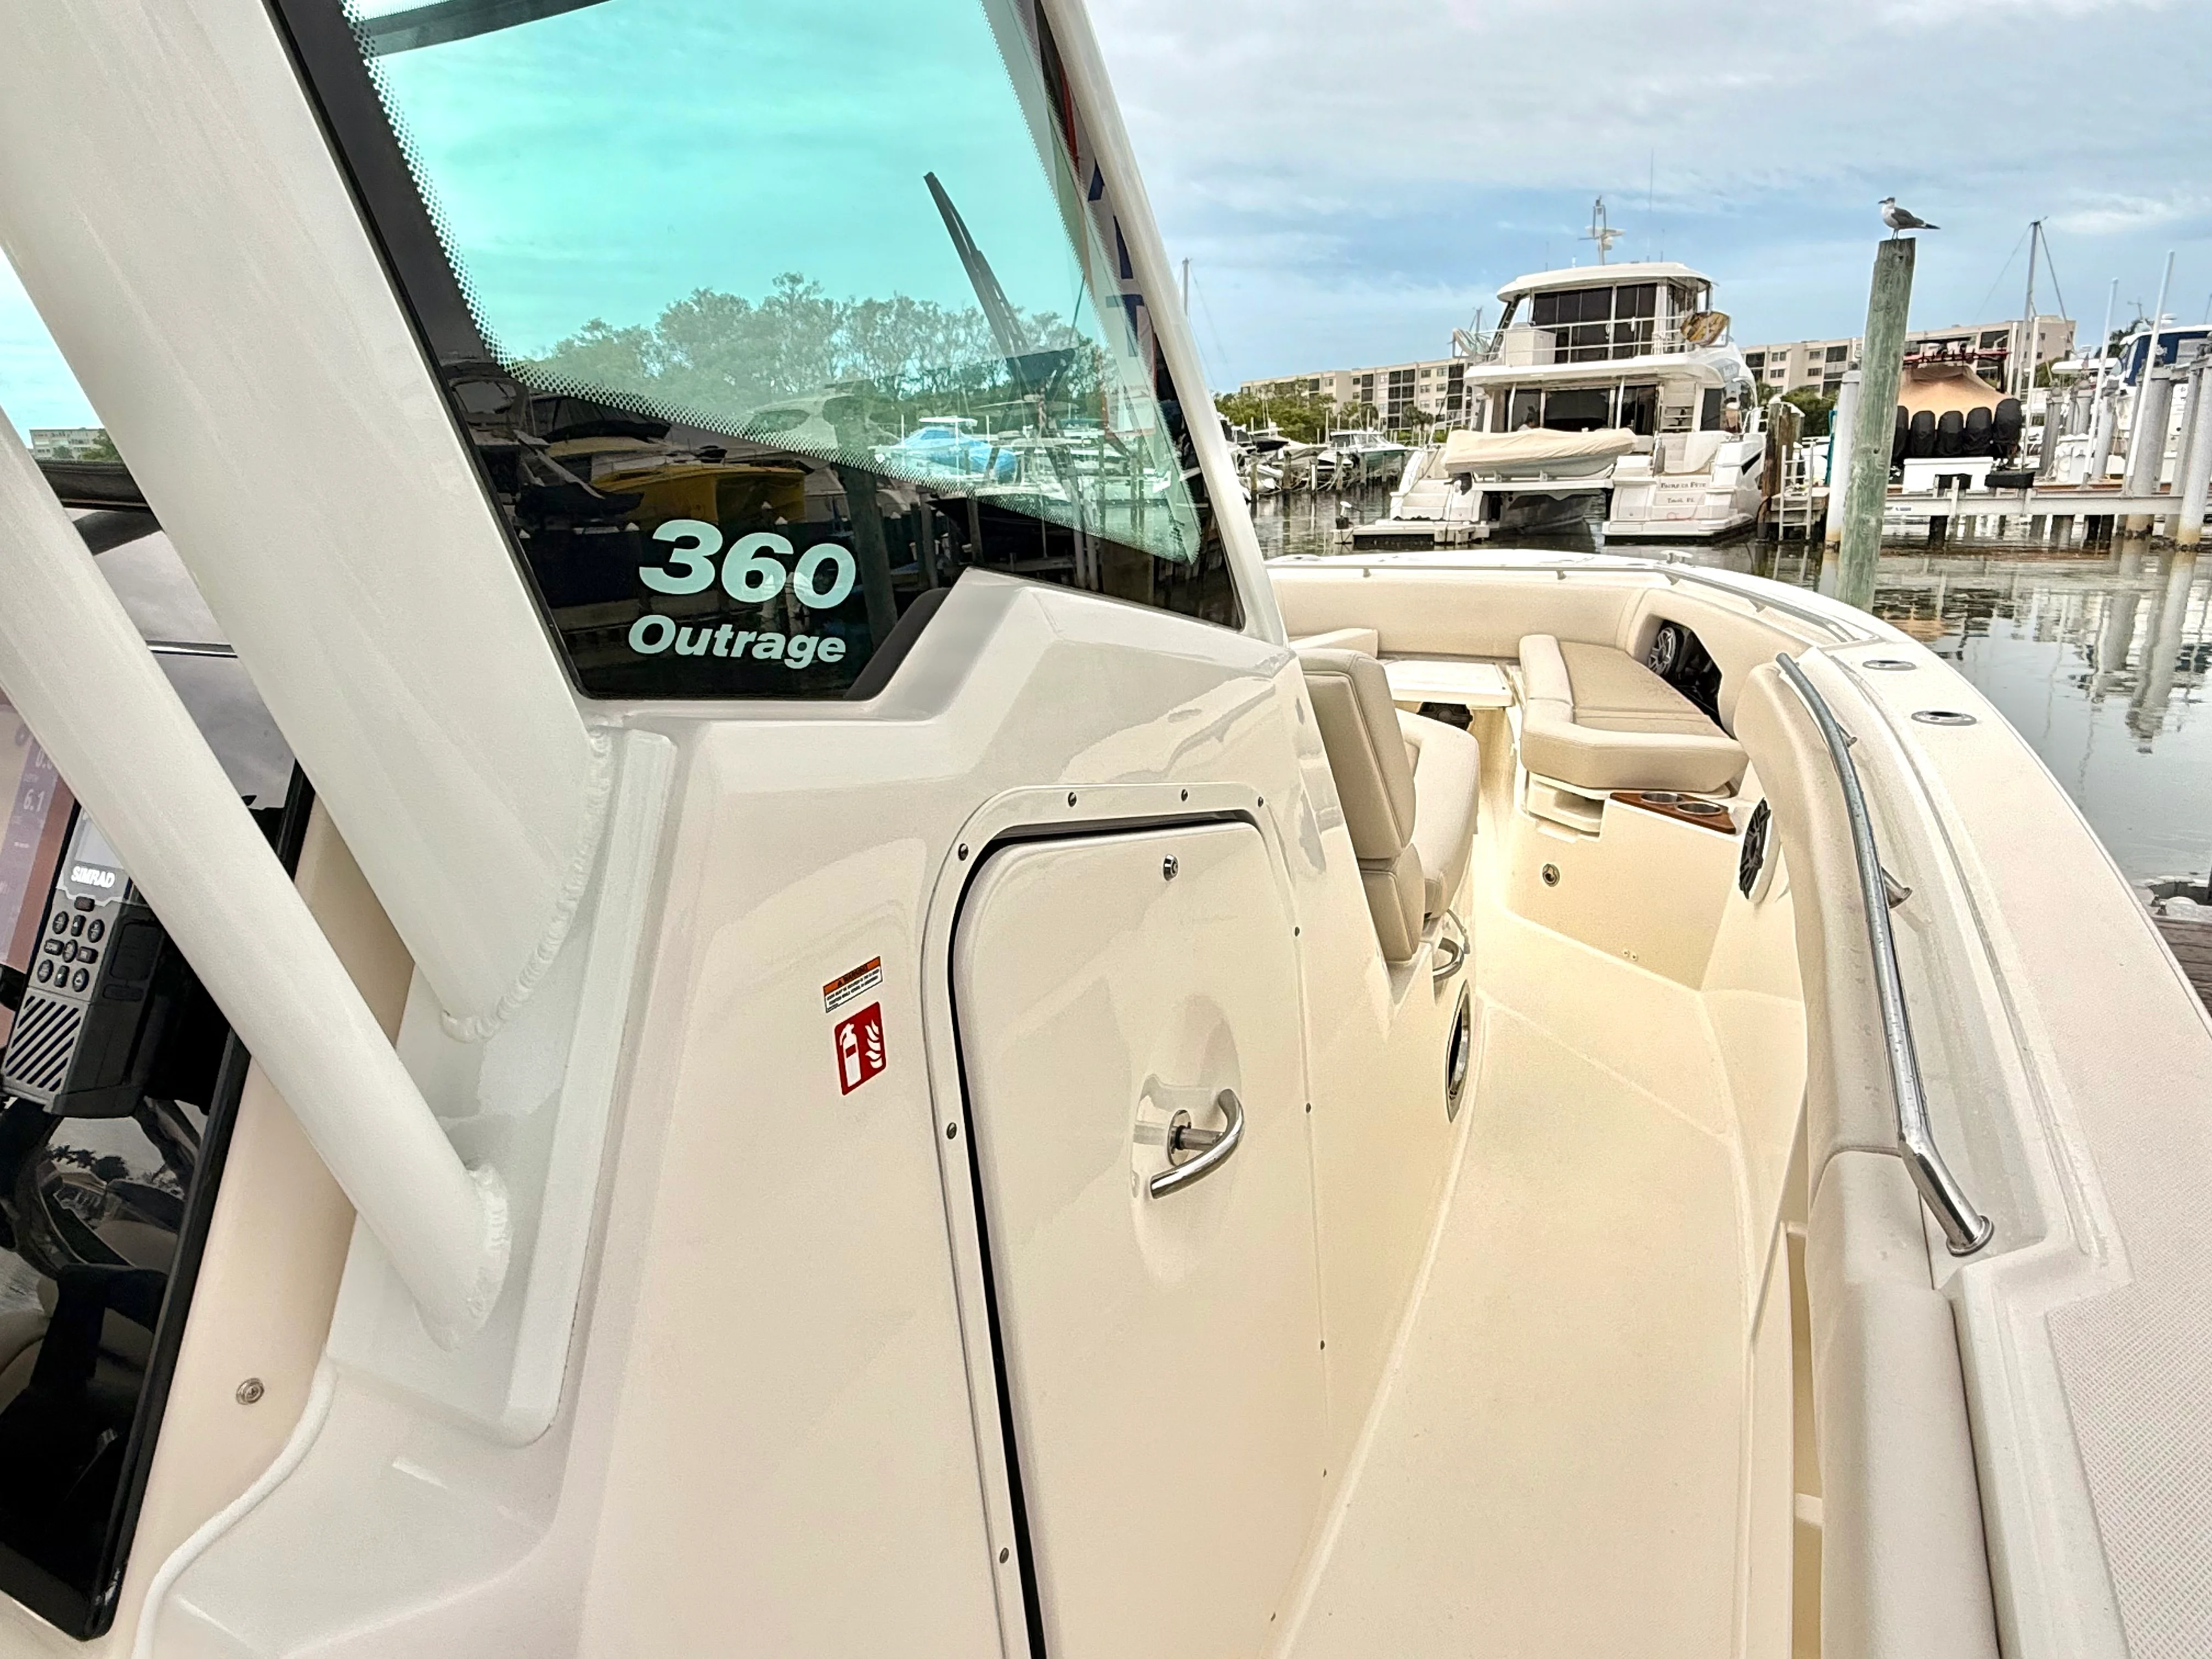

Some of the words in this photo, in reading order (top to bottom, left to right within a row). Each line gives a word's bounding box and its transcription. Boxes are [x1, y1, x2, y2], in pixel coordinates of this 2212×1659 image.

[639, 519, 856, 609] 360
[629, 614, 847, 669] Outrage
[23, 788, 45, 812] 6.1
[70, 866, 115, 889] SIMRAD
